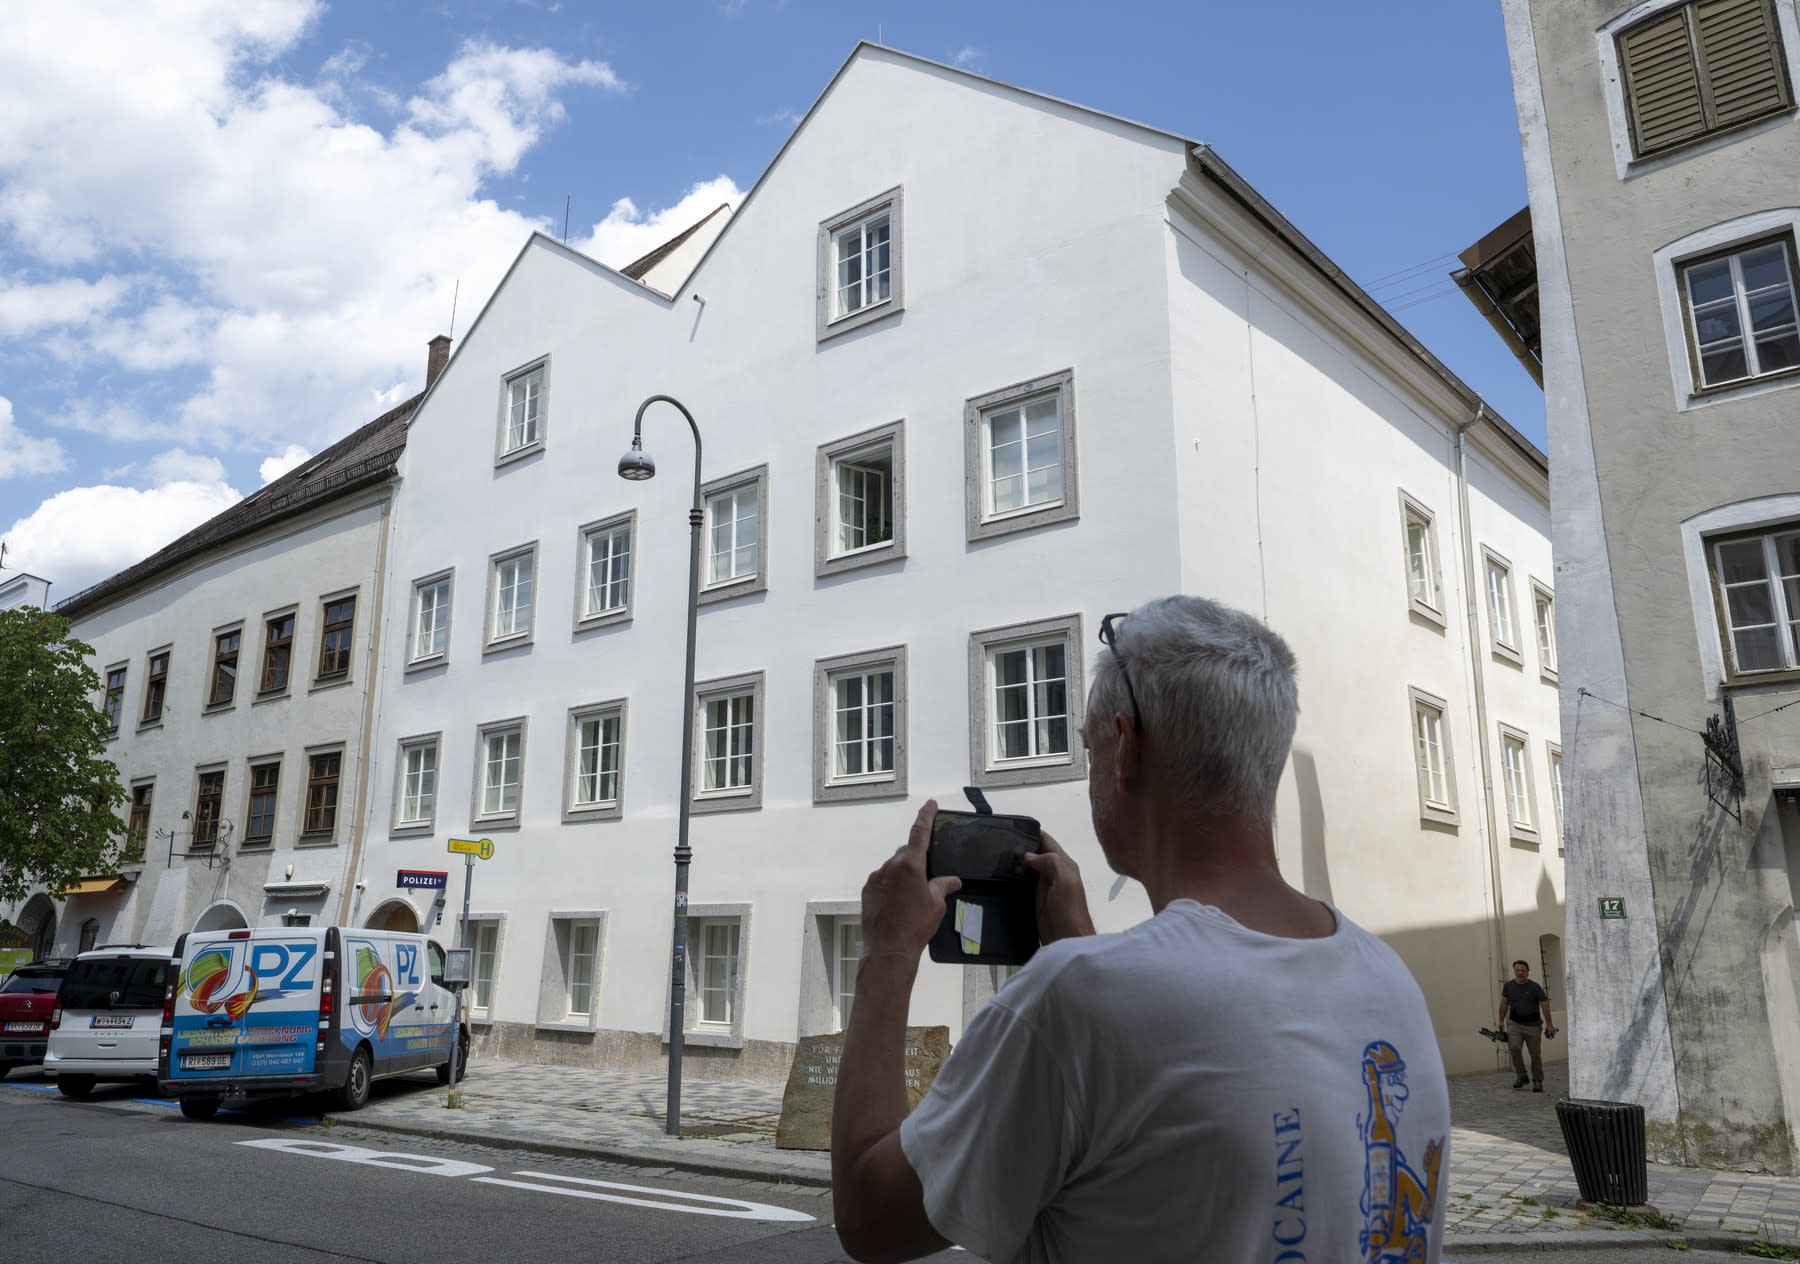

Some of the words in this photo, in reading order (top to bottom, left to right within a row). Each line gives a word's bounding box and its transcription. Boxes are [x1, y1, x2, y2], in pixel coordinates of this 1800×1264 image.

[481, 842, 491, 856] H
[403, 876, 437, 885] POLIZEI
[1602, 900, 1620, 910] 17
[249, 944, 317, 990] PZ
[395, 944, 419, 985] PZ
[812, 1044, 830, 1053] FÜR
[809, 1065, 822, 1073] NIE
